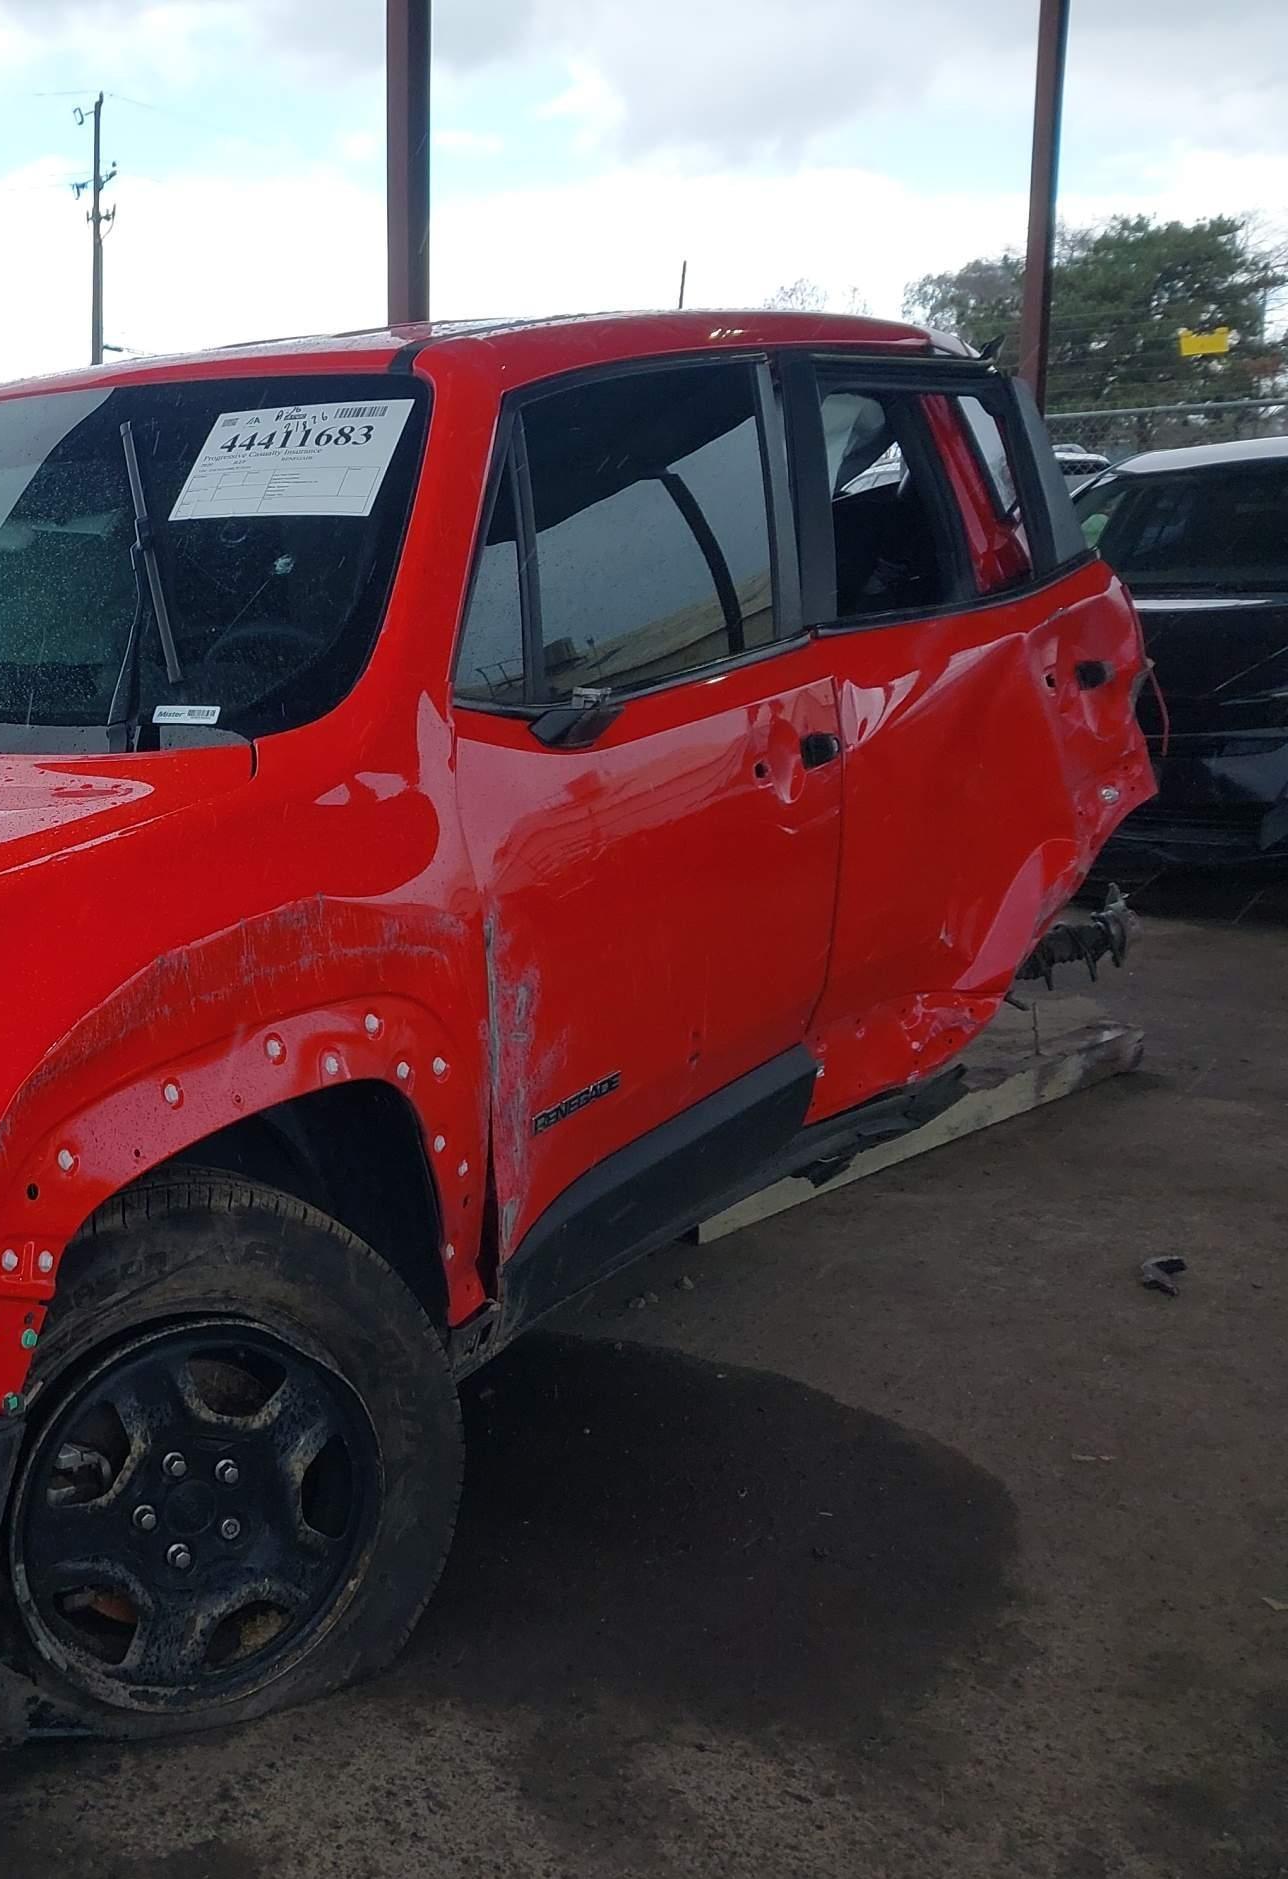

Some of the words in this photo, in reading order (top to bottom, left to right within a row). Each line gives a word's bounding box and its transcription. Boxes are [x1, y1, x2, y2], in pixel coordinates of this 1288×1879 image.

[219, 425, 375, 453] 44411683
[248, 450, 282, 458] Casualty
[283, 448, 323, 456] Insurance
[531, 1070, 622, 1136] RENEGADE
